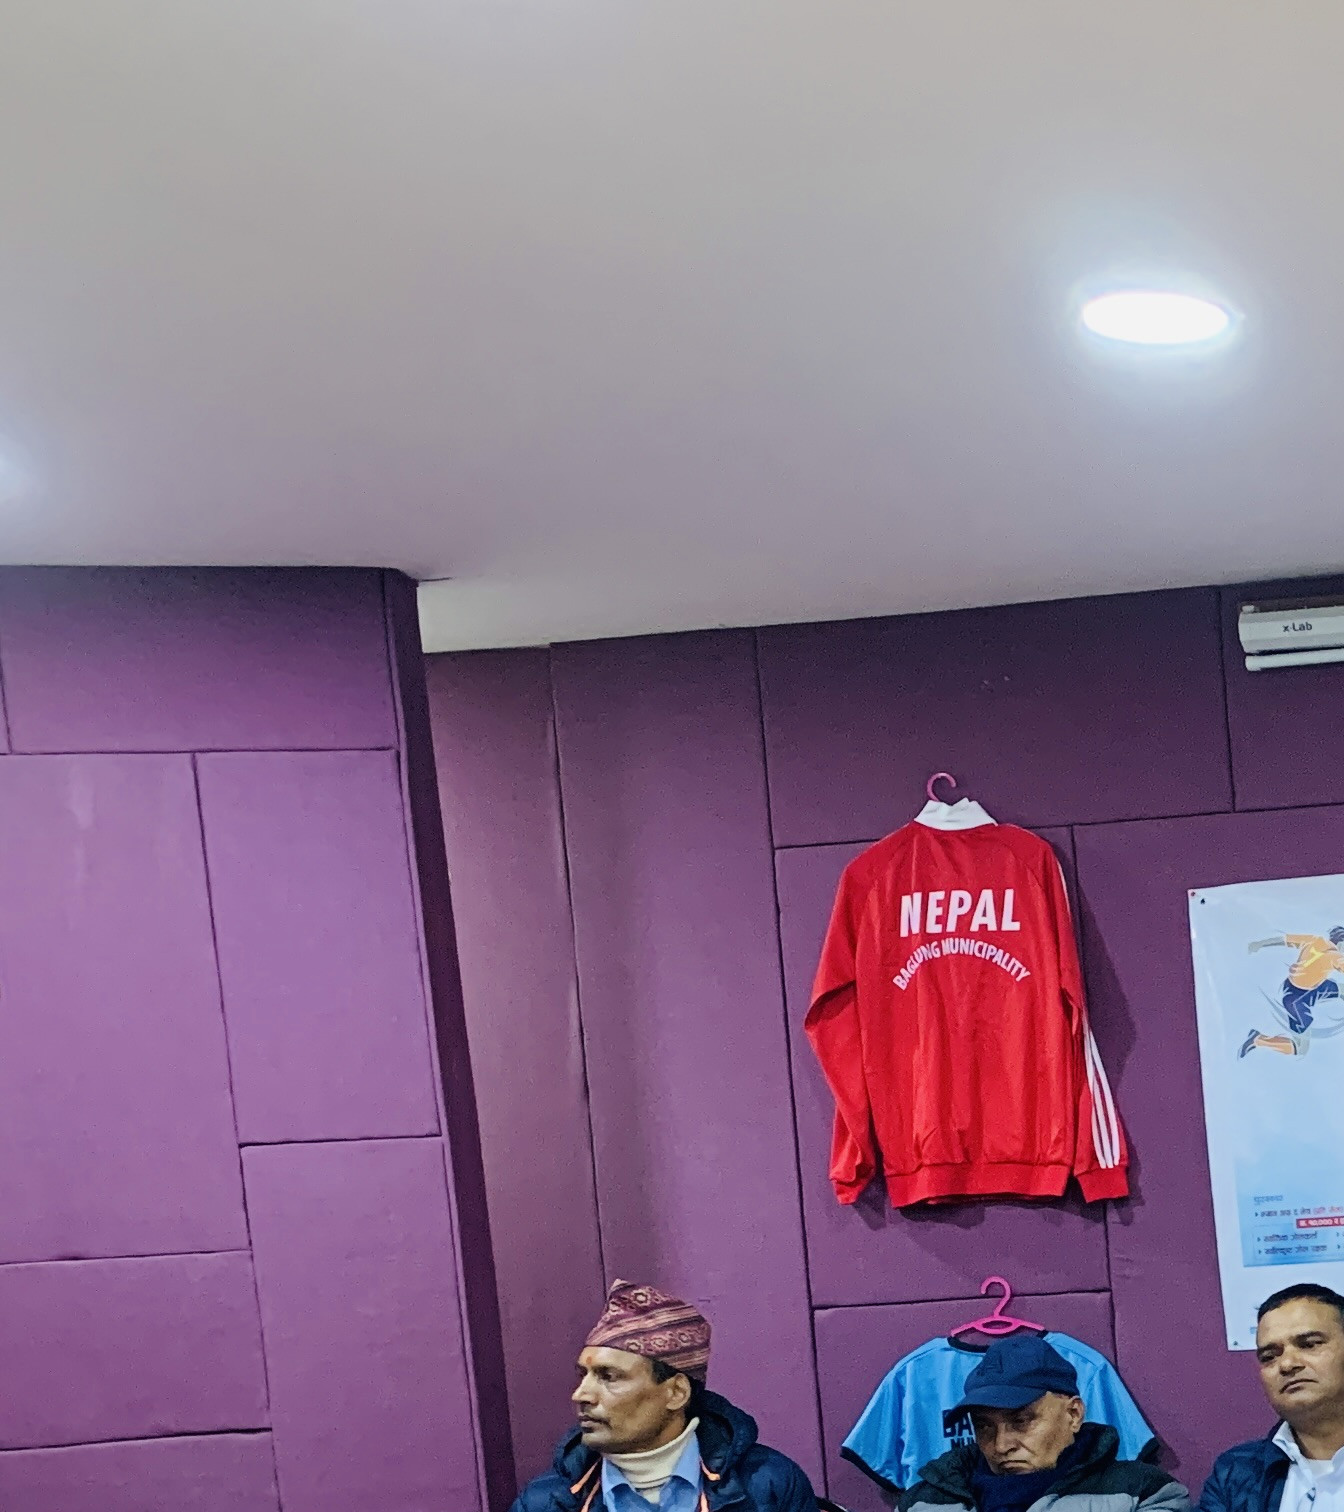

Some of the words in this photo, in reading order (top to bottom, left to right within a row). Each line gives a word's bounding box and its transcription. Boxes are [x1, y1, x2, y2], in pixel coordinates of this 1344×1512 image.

[900, 888, 1021, 938] NEPAL
[892, 941, 941, 991] BAGLUNG
[941, 937, 1031, 982] MUNICIPALITY
